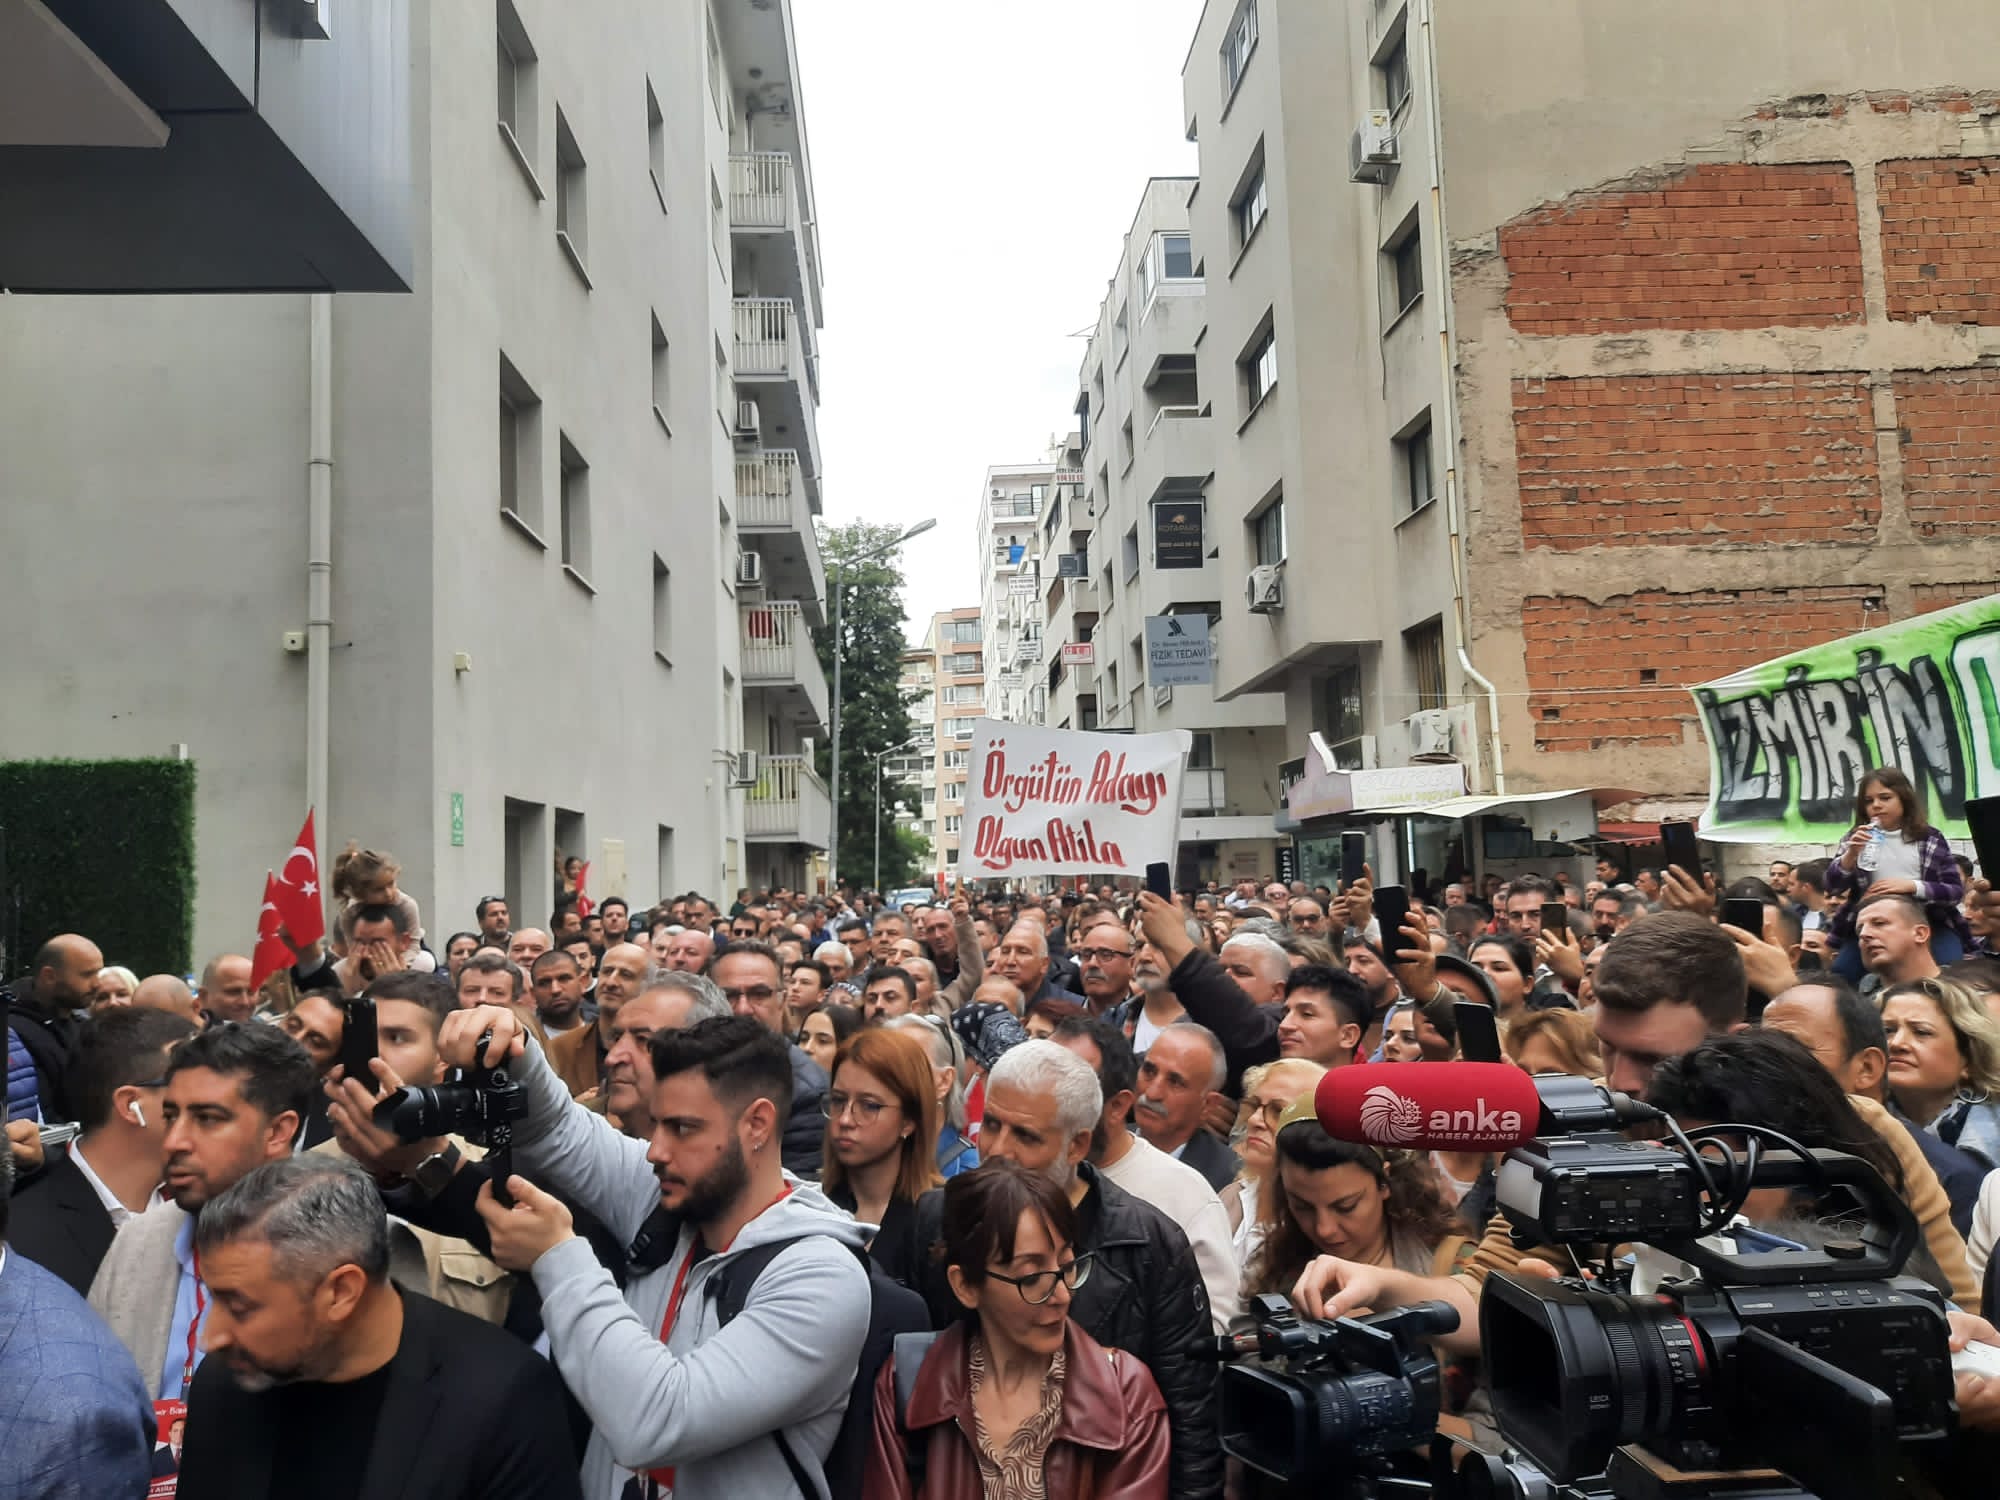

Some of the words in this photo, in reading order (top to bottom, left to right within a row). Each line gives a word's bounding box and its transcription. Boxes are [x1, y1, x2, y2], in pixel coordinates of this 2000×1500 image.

[1175, 647, 1207, 660] TEDAVİ
[983, 738, 1083, 813] Örgütün
[1086, 750, 1167, 815] Adayı
[974, 815, 1047, 870] Olgun
[1047, 817, 1127, 867] Atila
[1429, 1098, 1521, 1131] anka
[1427, 1132, 1470, 1141] HABER
[1473, 1132, 1519, 1141] AJANSI
